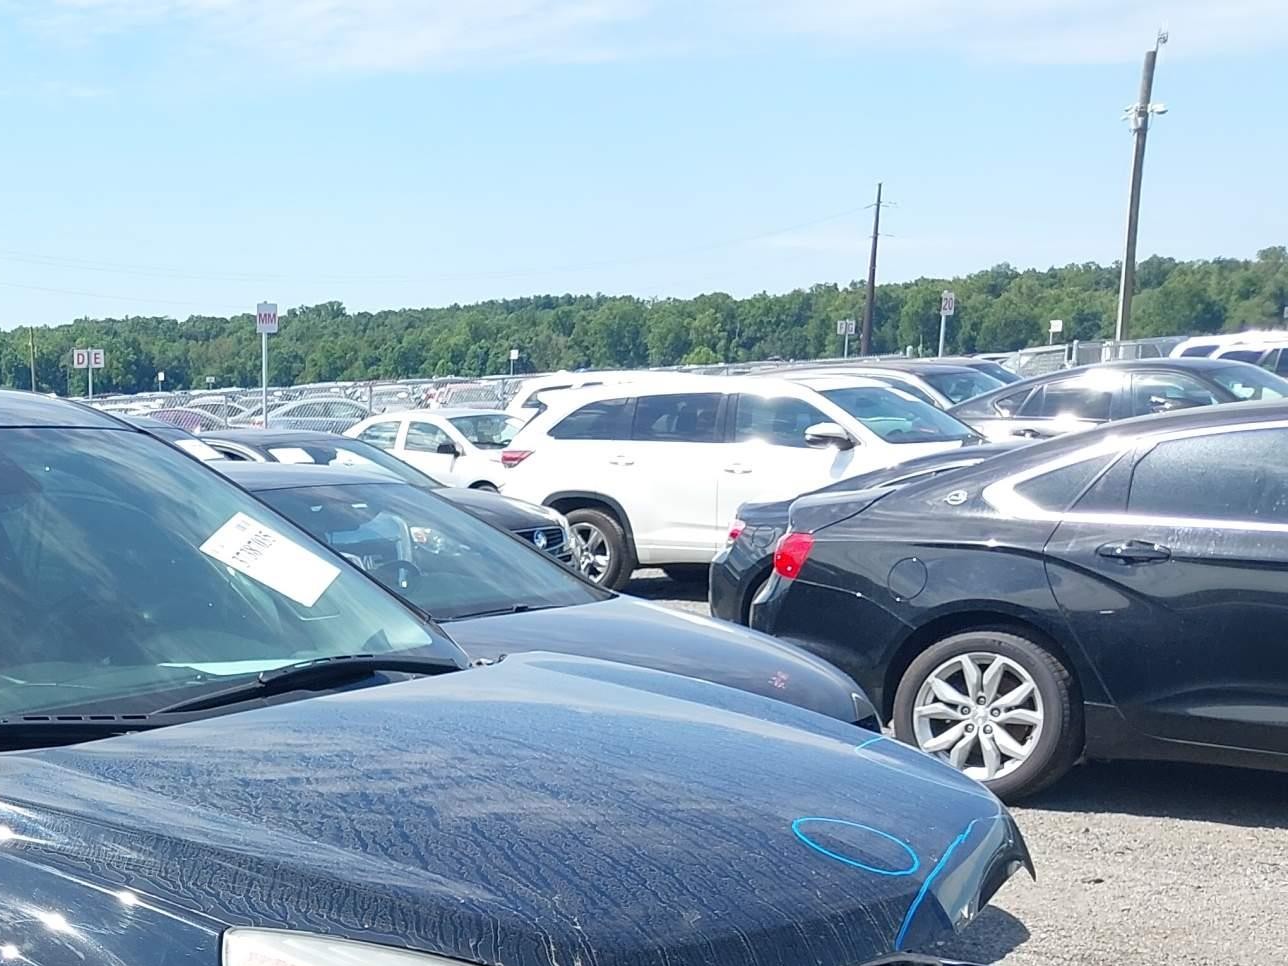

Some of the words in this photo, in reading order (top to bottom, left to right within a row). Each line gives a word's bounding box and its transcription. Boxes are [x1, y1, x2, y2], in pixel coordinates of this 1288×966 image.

[943, 297, 953, 311] 20
[258, 313, 277, 325] MM
[93, 352, 102, 365] E
